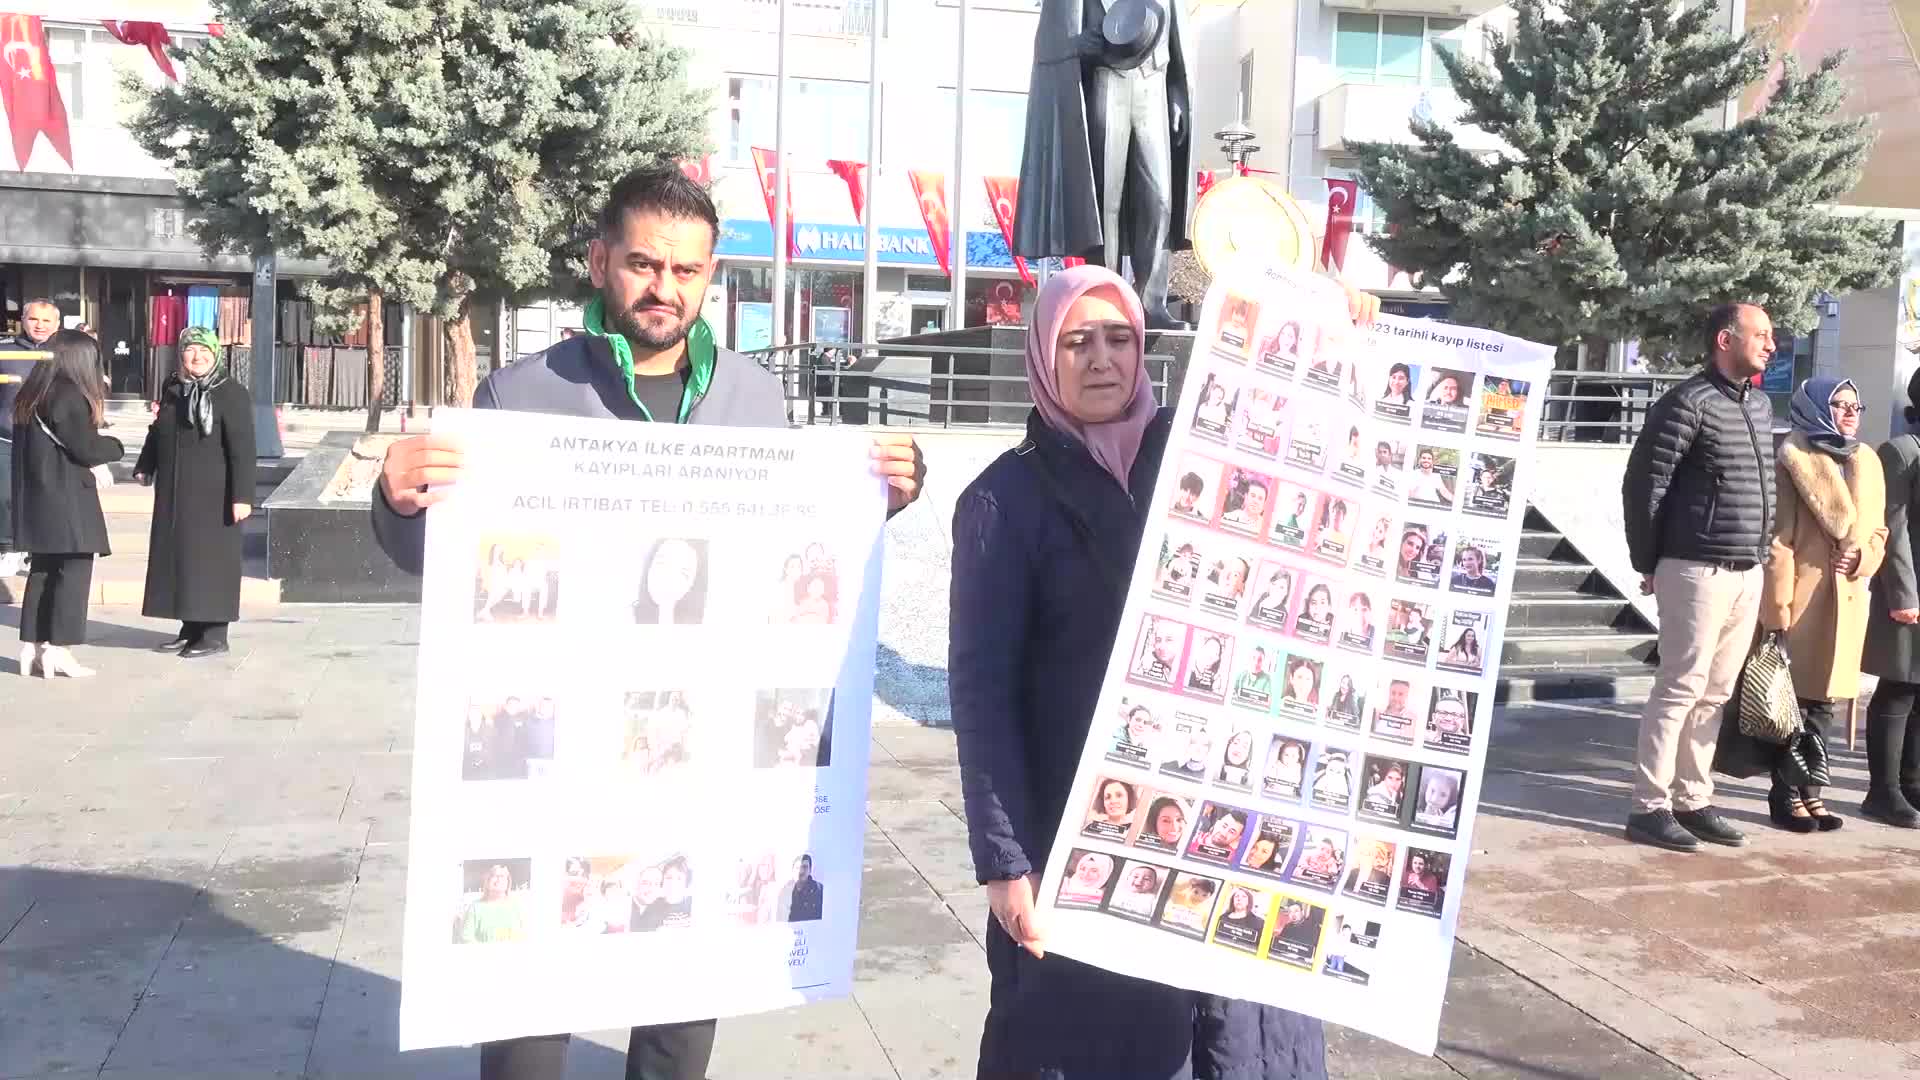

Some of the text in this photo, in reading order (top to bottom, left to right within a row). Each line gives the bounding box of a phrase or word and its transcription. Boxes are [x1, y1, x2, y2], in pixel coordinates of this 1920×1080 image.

[822, 231, 930, 254] HALBANK
[1393, 326, 1429, 340] tarihli
[1466, 338, 1504, 353] listesi
[550, 436, 638, 453] ANTAKYA
[689, 444, 795, 462] APARTMANI
[574, 461, 769, 481] KAYIPLARI ARANIYOR
